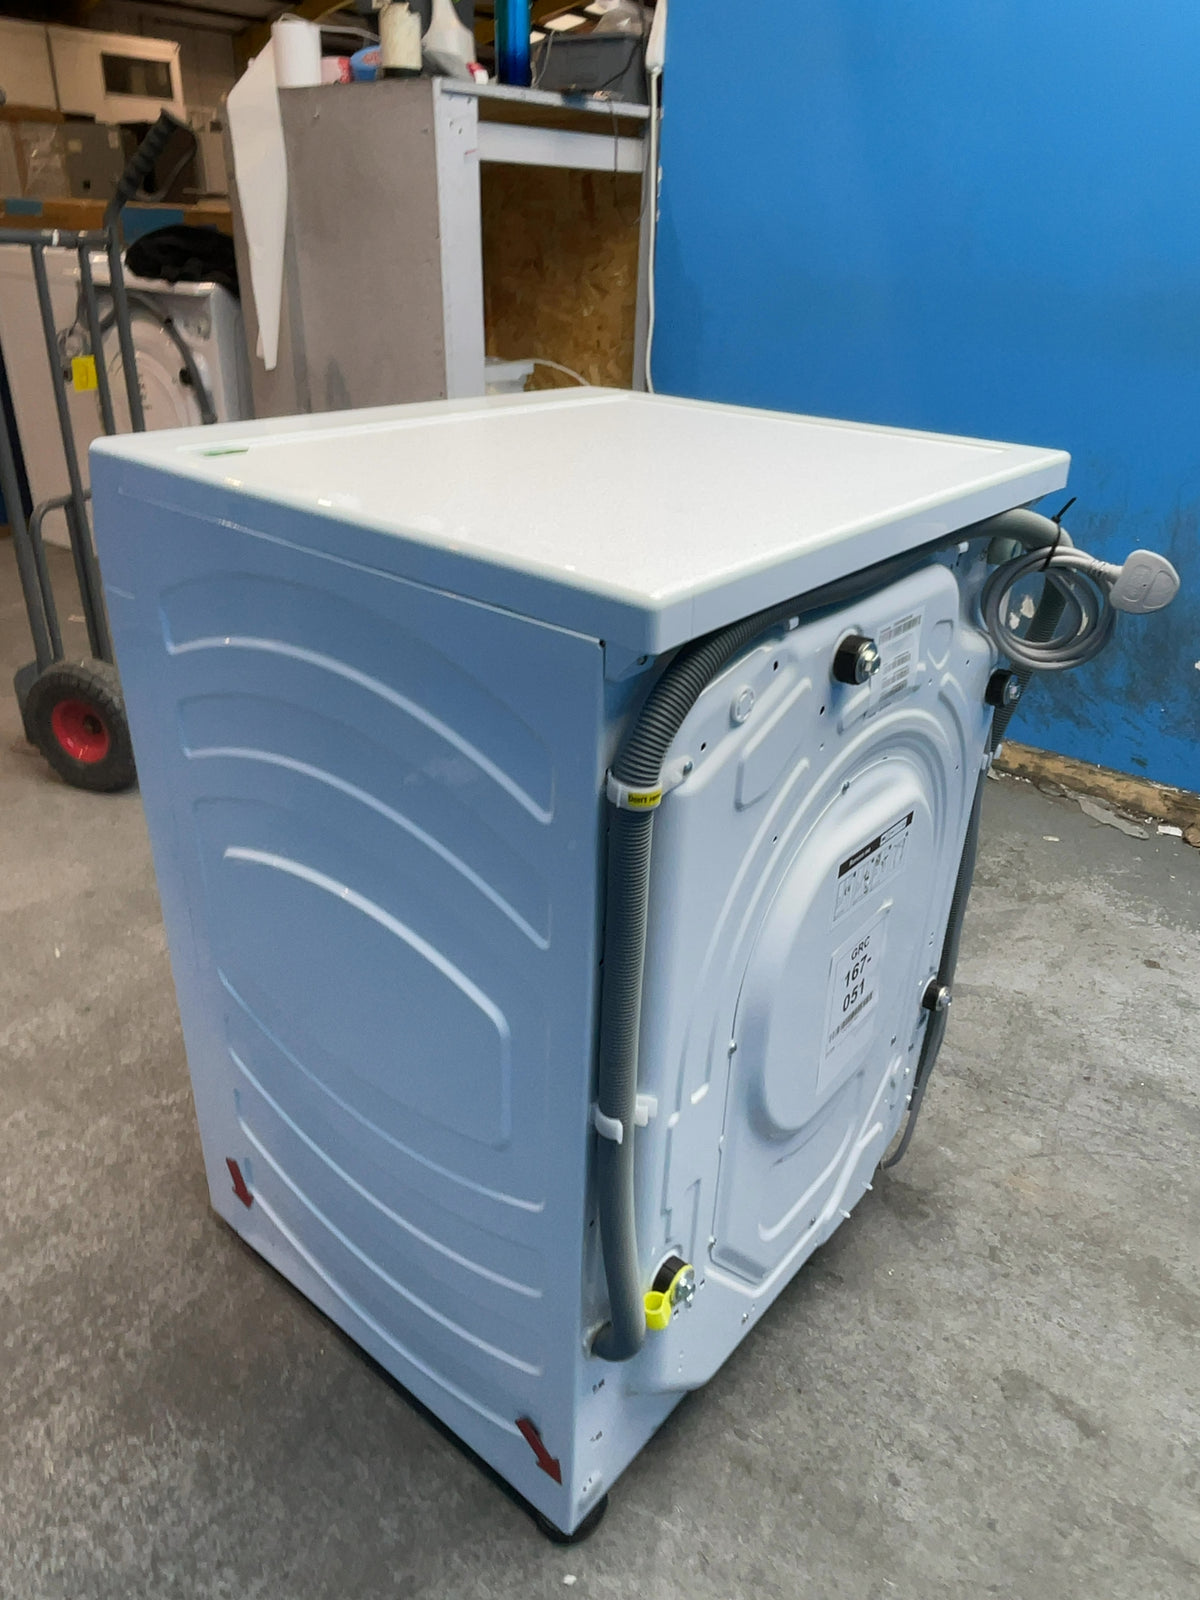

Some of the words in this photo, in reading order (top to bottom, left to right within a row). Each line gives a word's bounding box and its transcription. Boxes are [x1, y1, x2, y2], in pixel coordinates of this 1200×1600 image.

[851, 935, 871, 960] GRC
[844, 953, 872, 987] 167-
[842, 978, 865, 1012] 051
